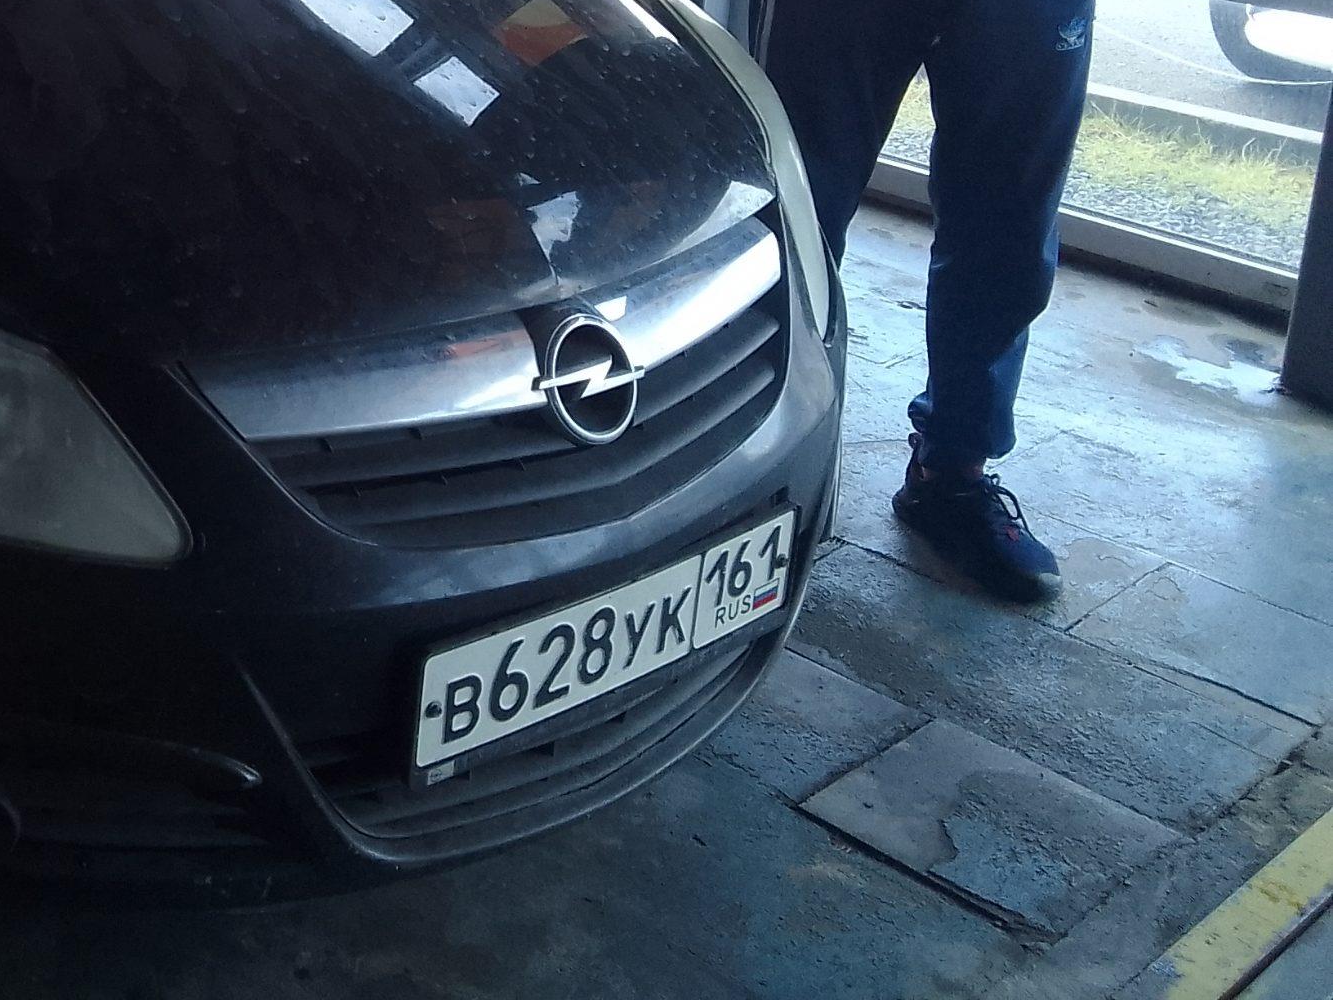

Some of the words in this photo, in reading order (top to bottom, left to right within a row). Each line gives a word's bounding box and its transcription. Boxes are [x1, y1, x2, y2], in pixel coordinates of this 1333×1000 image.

[442, 585, 693, 745] В628УК
[704, 525, 781, 607] 161
[714, 598, 753, 629] RUS
